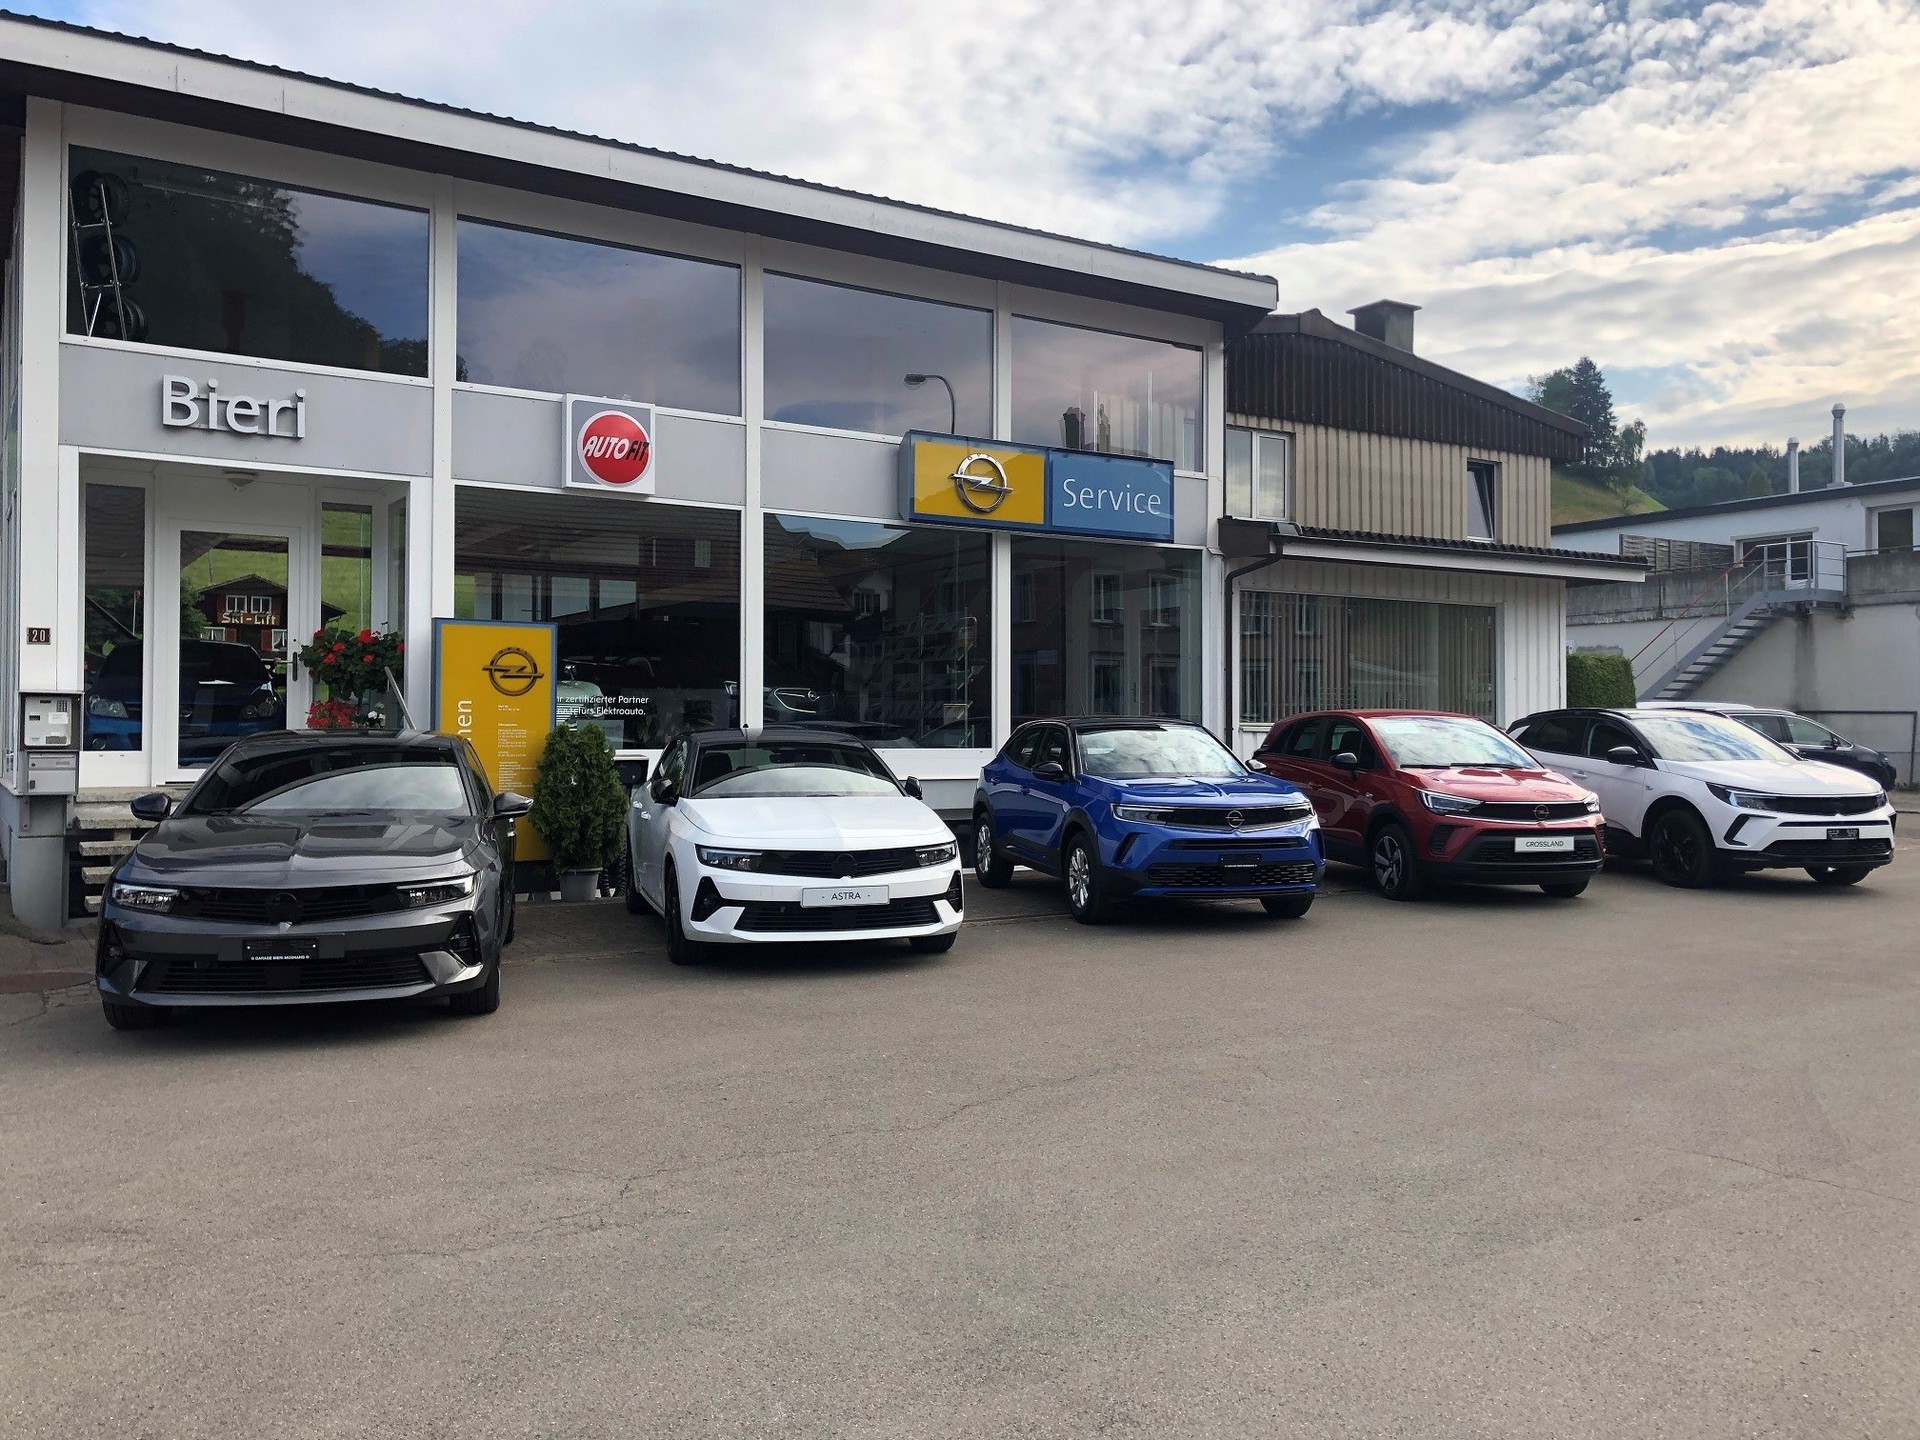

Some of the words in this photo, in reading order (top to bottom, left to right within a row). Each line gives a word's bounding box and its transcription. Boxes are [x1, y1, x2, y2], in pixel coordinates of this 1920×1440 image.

[162, 374, 306, 438] Bieri
[583, 435, 650, 462] AUTOFIT
[1063, 478, 1161, 515] Service
[32, 629, 46, 643] 20
[565, 695, 616, 705] zertifizierter
[618, 695, 649, 705] Partner
[596, 706, 646, 716] Elektroauto.
[830, 891, 862, 901] ASTRA
